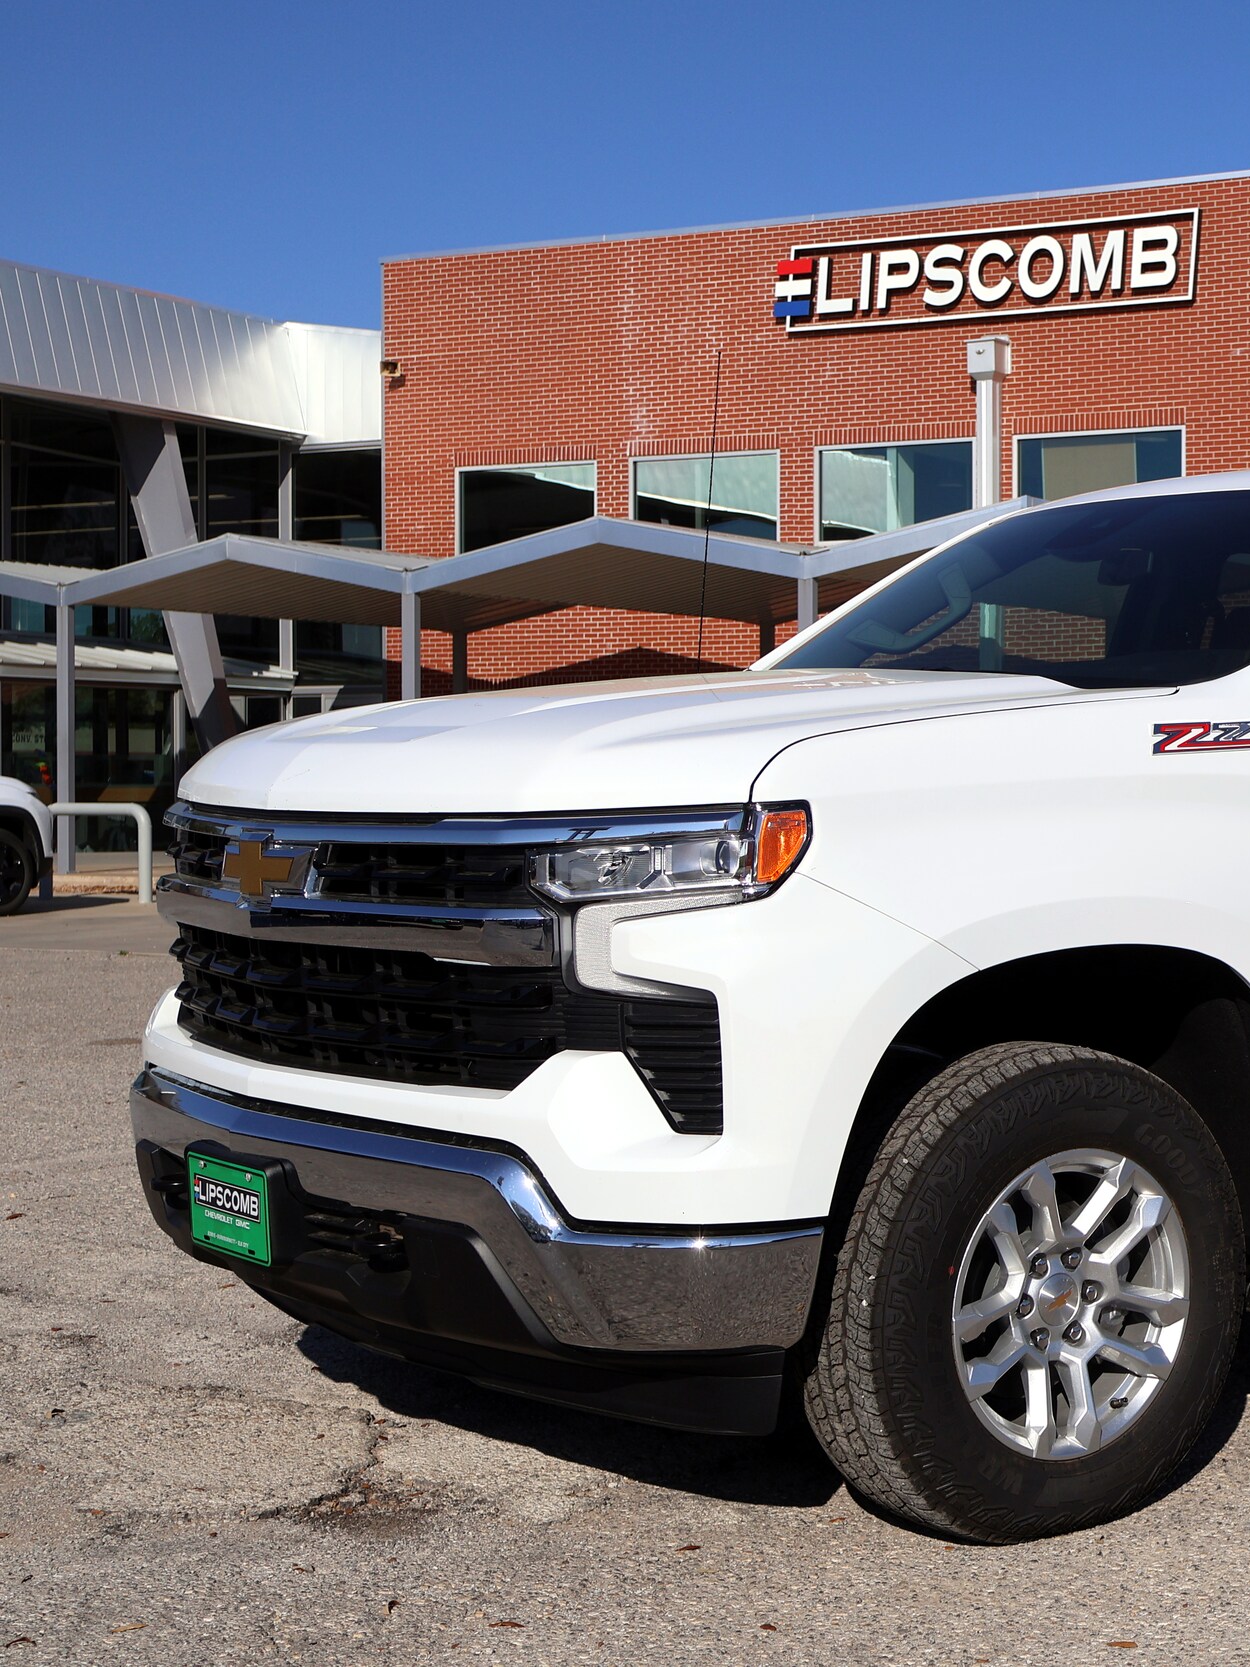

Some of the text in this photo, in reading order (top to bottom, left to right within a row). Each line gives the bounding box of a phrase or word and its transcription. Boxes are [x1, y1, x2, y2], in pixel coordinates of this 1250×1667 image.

[814, 225, 1179, 314] LIPSCOMB
[199, 1181, 259, 1216] LIPSCOMB
[205, 1209, 250, 1229] CHEVROLET GMC
